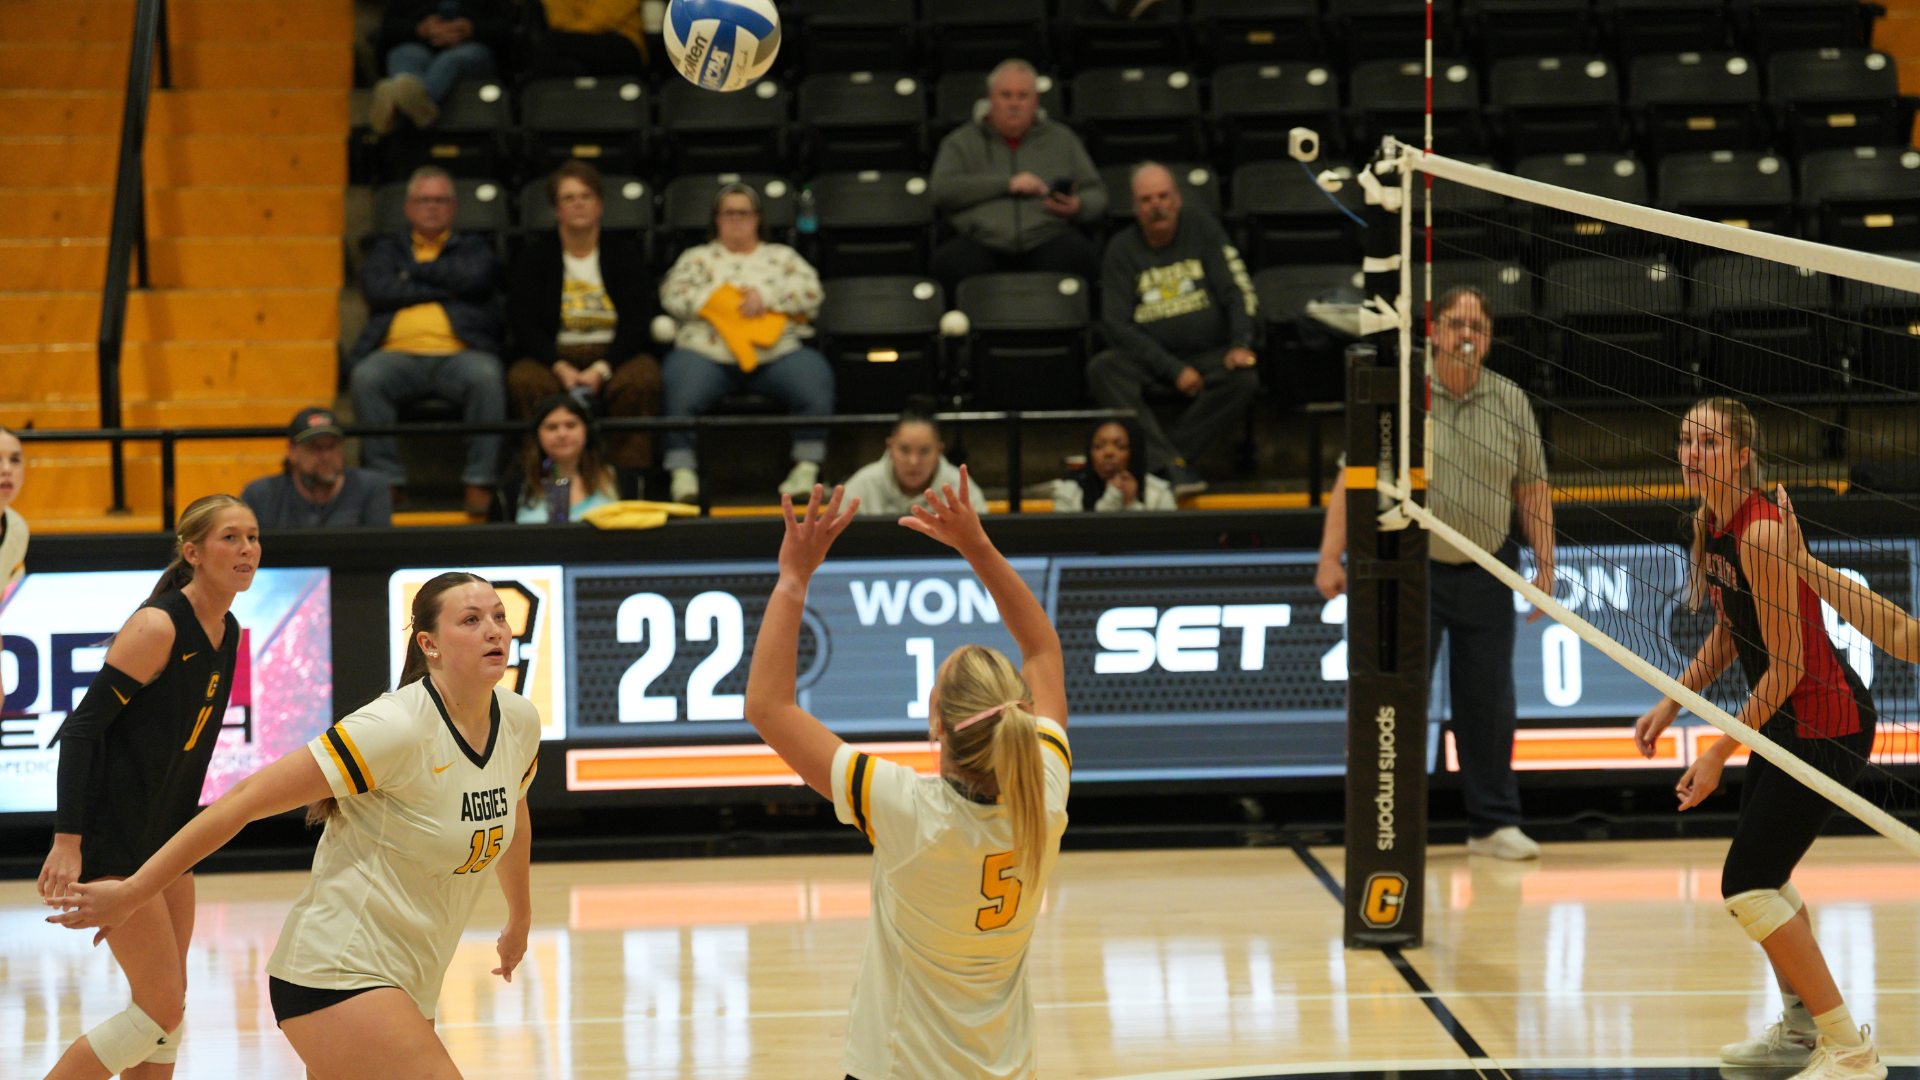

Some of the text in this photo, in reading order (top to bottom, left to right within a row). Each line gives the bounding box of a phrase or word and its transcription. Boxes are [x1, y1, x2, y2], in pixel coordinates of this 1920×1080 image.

[702, 48, 730, 88] NCAA
[848, 578, 1001, 626] WON
[1094, 603, 1291, 674] SET
[616, 591, 745, 723] 22
[906, 637, 935, 719] 1
[1541, 622, 1582, 708] 0
[461, 787, 508, 822] AGGIES
[1374, 705, 1398, 851] sports imports
[453, 825, 503, 875] 15
[975, 851, 1022, 931] 5
